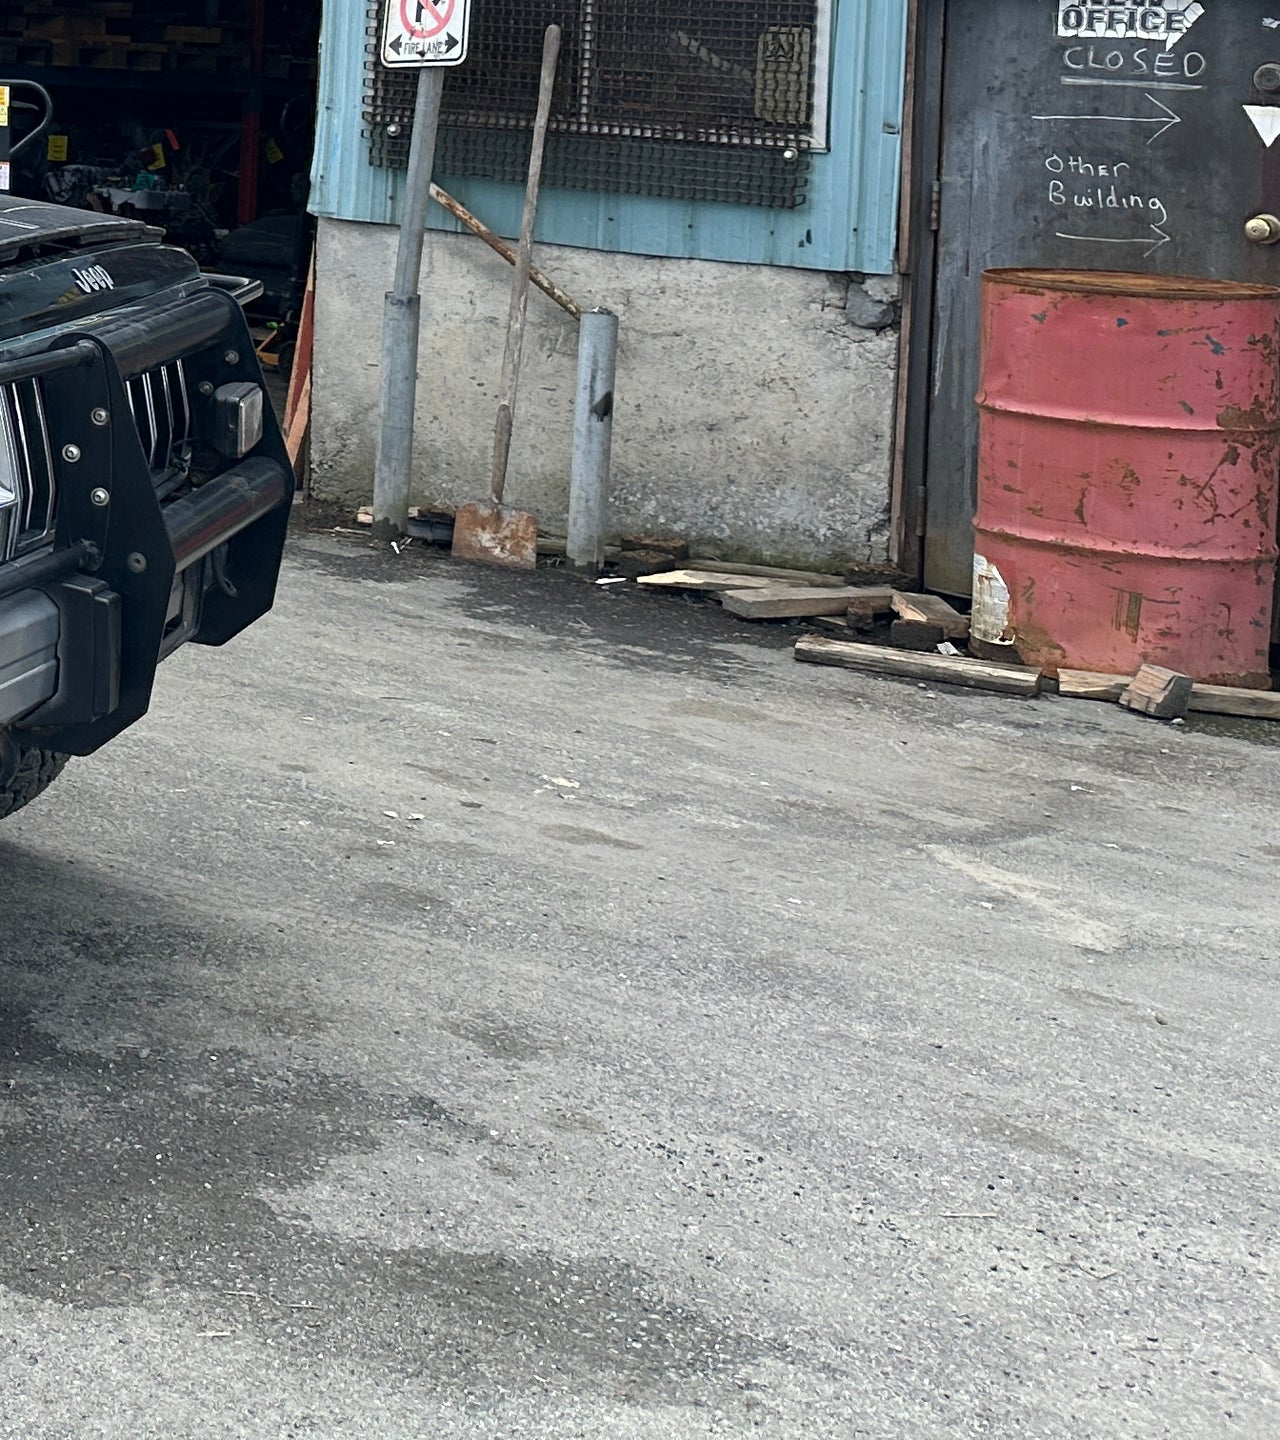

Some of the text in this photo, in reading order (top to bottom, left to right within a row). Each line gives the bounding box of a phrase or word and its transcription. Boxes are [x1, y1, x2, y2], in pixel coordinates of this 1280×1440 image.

[1062, 5, 1186, 32] OFFICE
[1063, 44, 1207, 78] CLOSED
[1048, 179, 1168, 227] Building
[71, 264, 114, 294] Jeep
